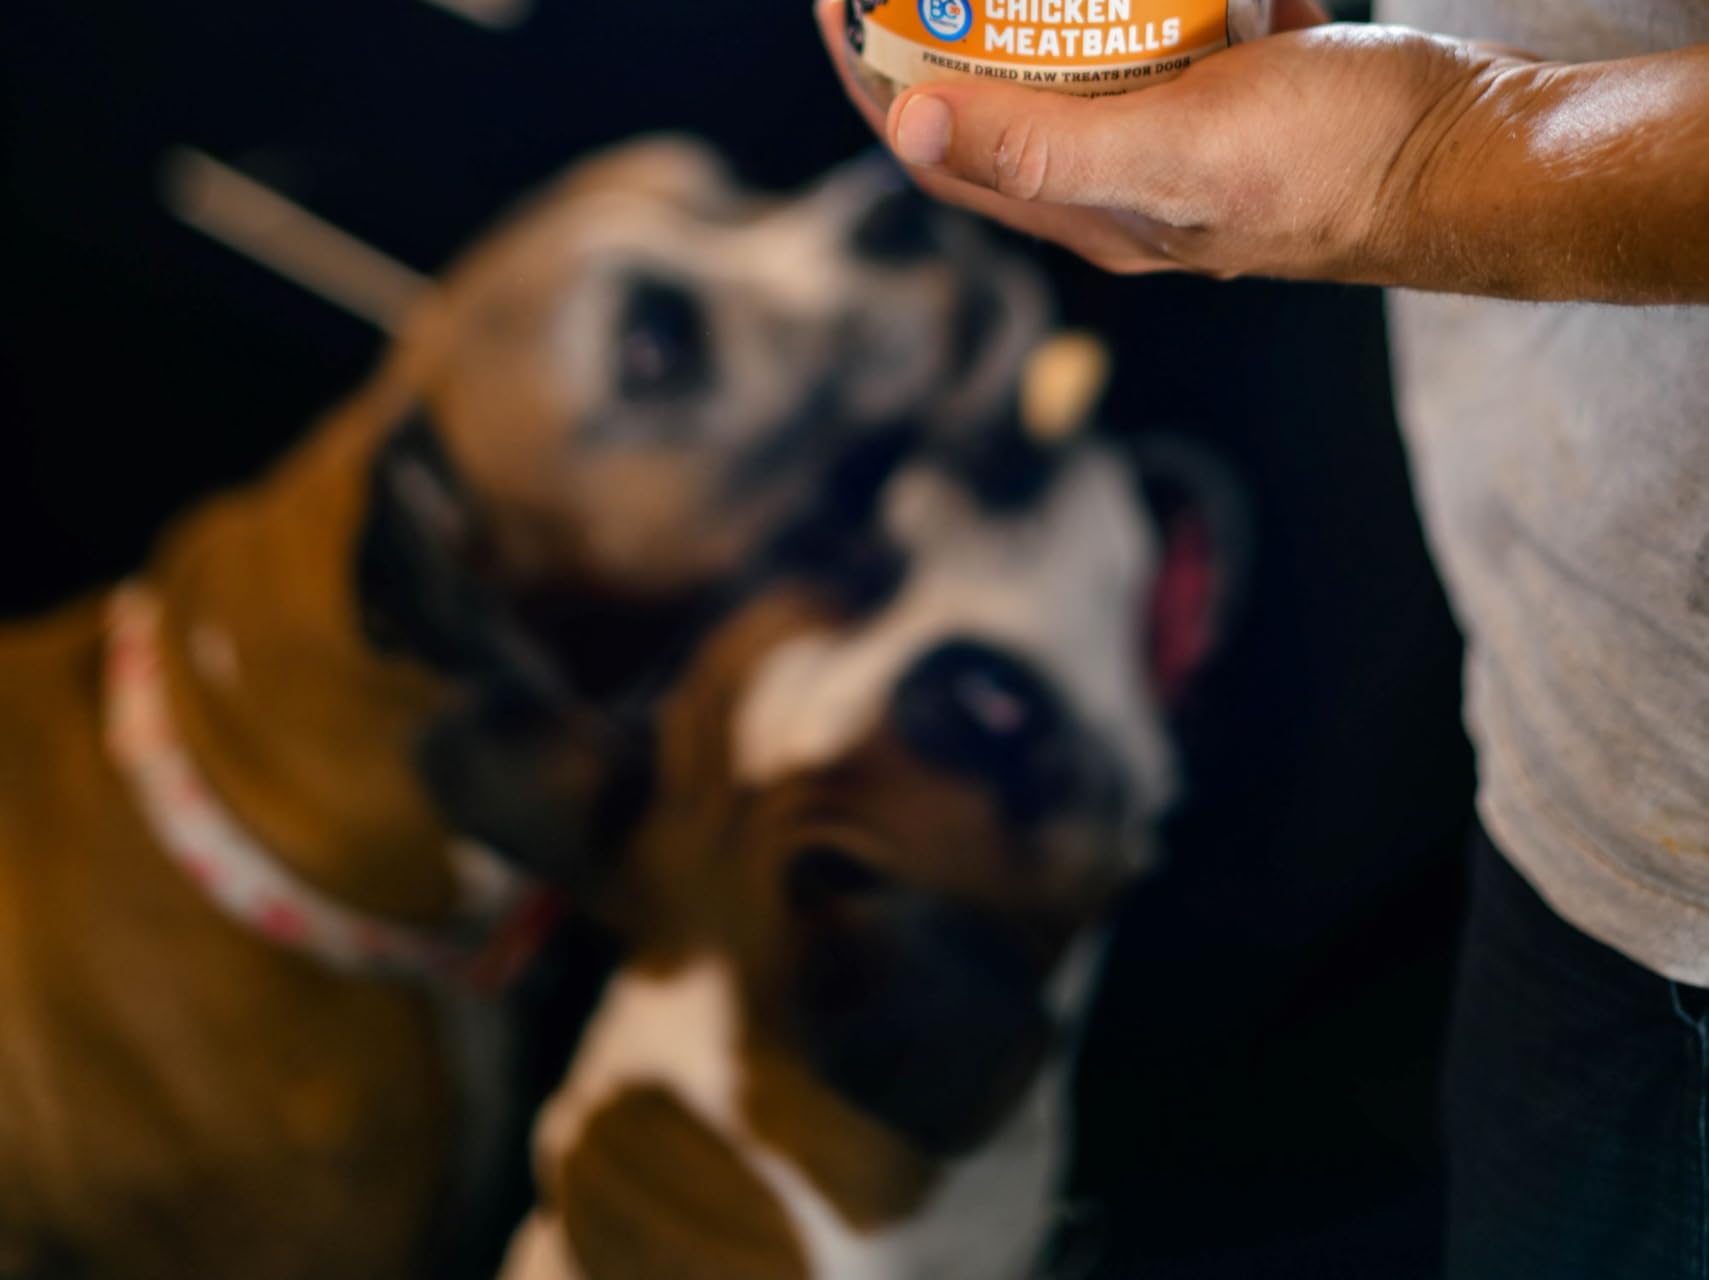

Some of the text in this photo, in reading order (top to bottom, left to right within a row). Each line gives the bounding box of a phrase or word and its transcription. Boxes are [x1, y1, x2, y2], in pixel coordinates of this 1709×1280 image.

[985, 17, 1181, 57] MEATBALLS
[922, 51, 1191, 83] FREEZE DRIED RAW TREATS FOR DOGS
